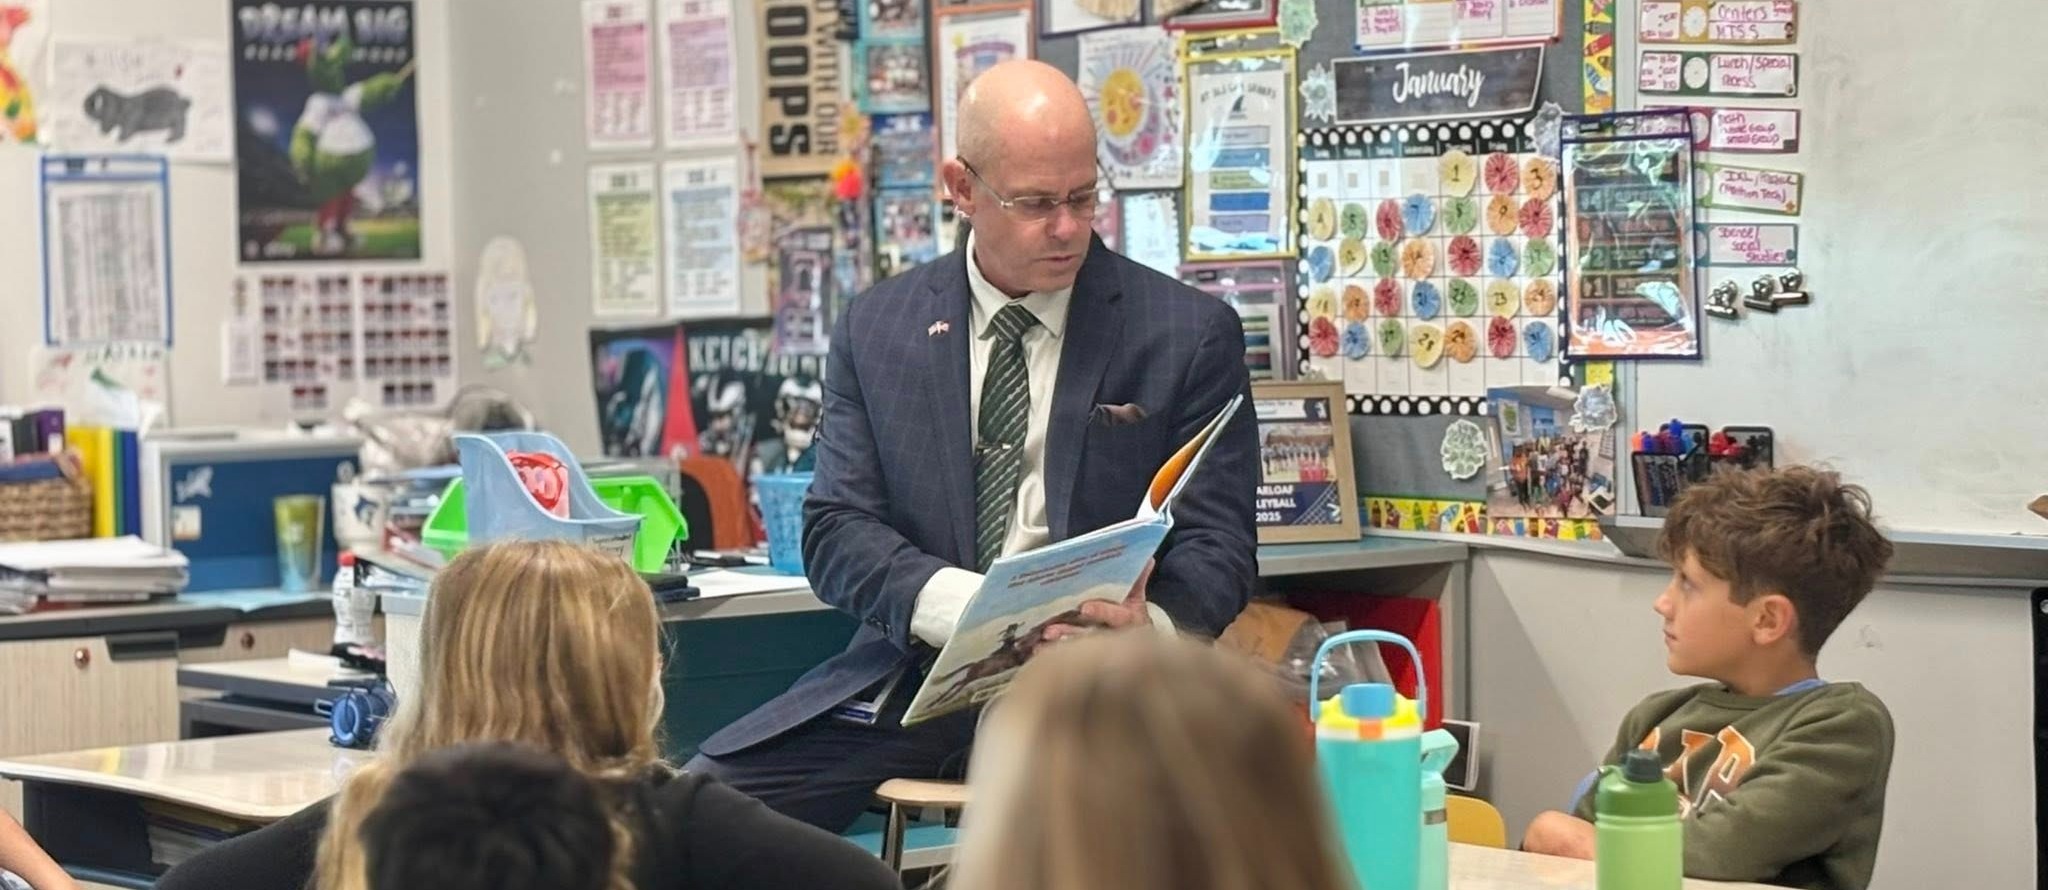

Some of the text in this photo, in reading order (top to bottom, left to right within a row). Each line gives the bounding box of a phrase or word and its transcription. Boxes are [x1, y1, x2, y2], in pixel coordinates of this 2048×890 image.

[238, 2, 408, 43] DREAM BIG
[1392, 62, 1485, 108] January
[816, 103, 839, 155] OUR
[1530, 167, 1544, 190] 3
[1418, 333, 1434, 351] 28
[1255, 511, 1282, 522] 2025
